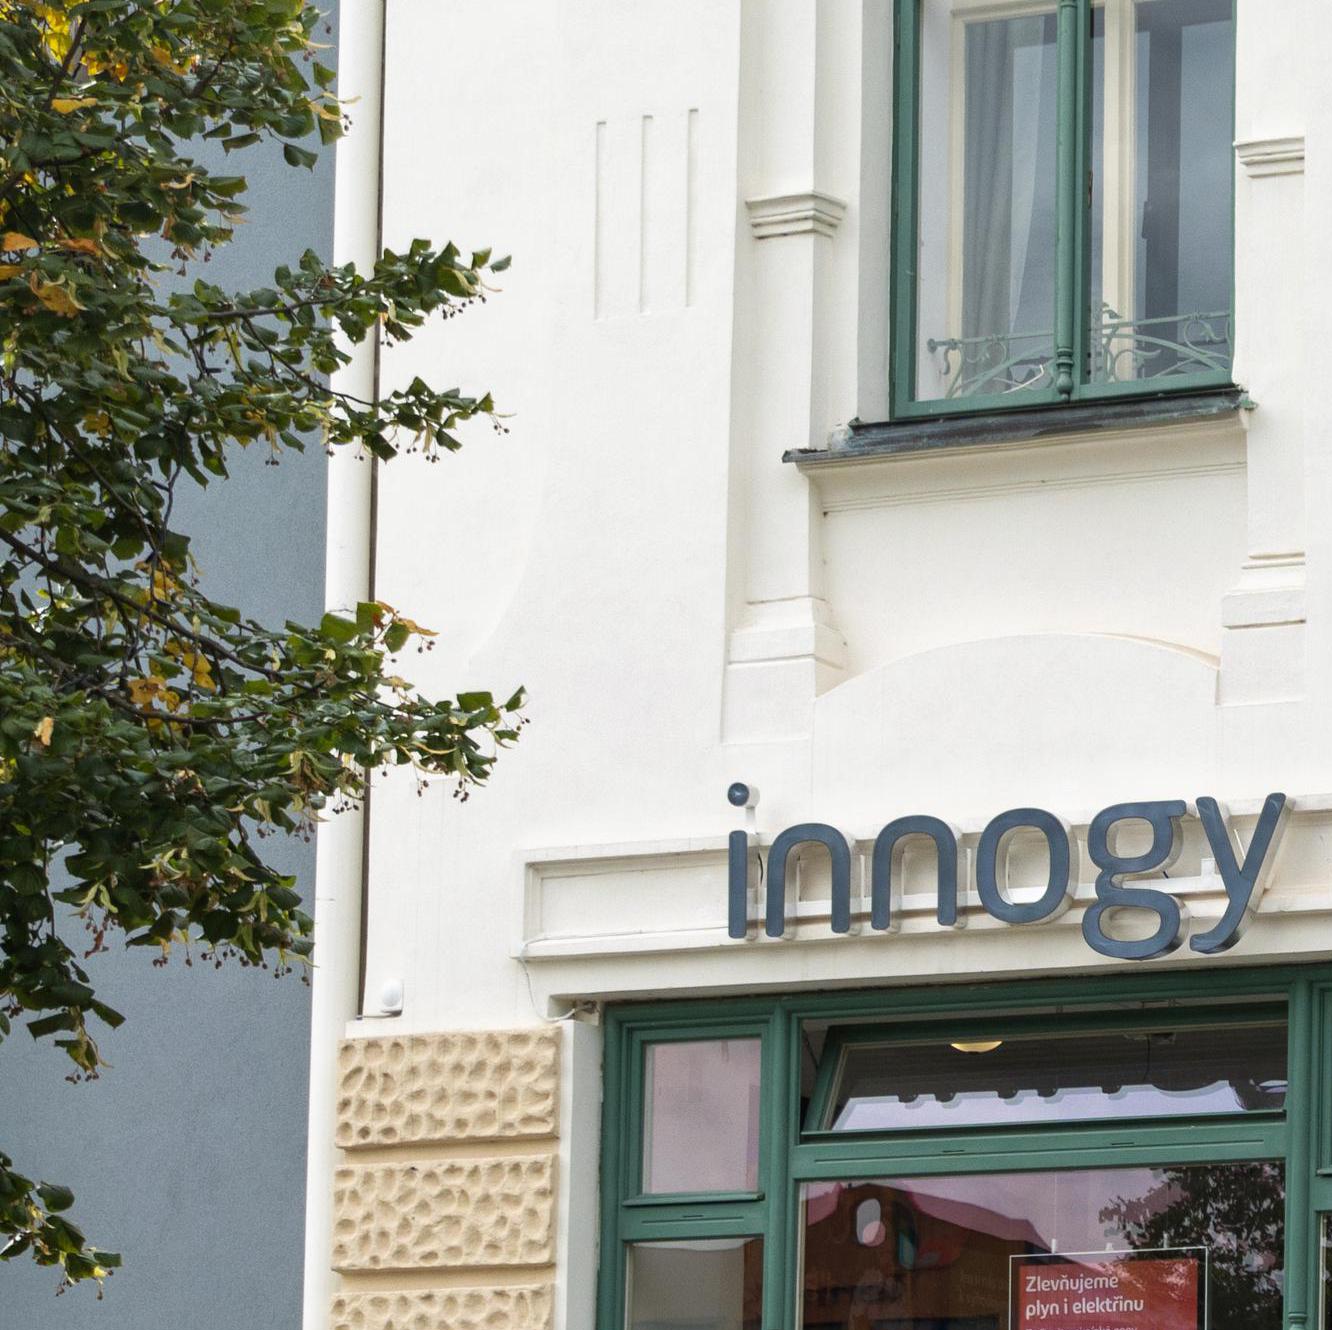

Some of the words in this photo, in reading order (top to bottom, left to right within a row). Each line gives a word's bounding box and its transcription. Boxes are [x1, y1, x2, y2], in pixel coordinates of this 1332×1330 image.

[726, 781, 1289, 961] innogy
[1025, 1273, 1119, 1294] Zlevňujeme
[1025, 1299, 1060, 1320] plyn
[1063, 1298, 1068, 1315] i
[1072, 1295, 1145, 1314] elektřinu
